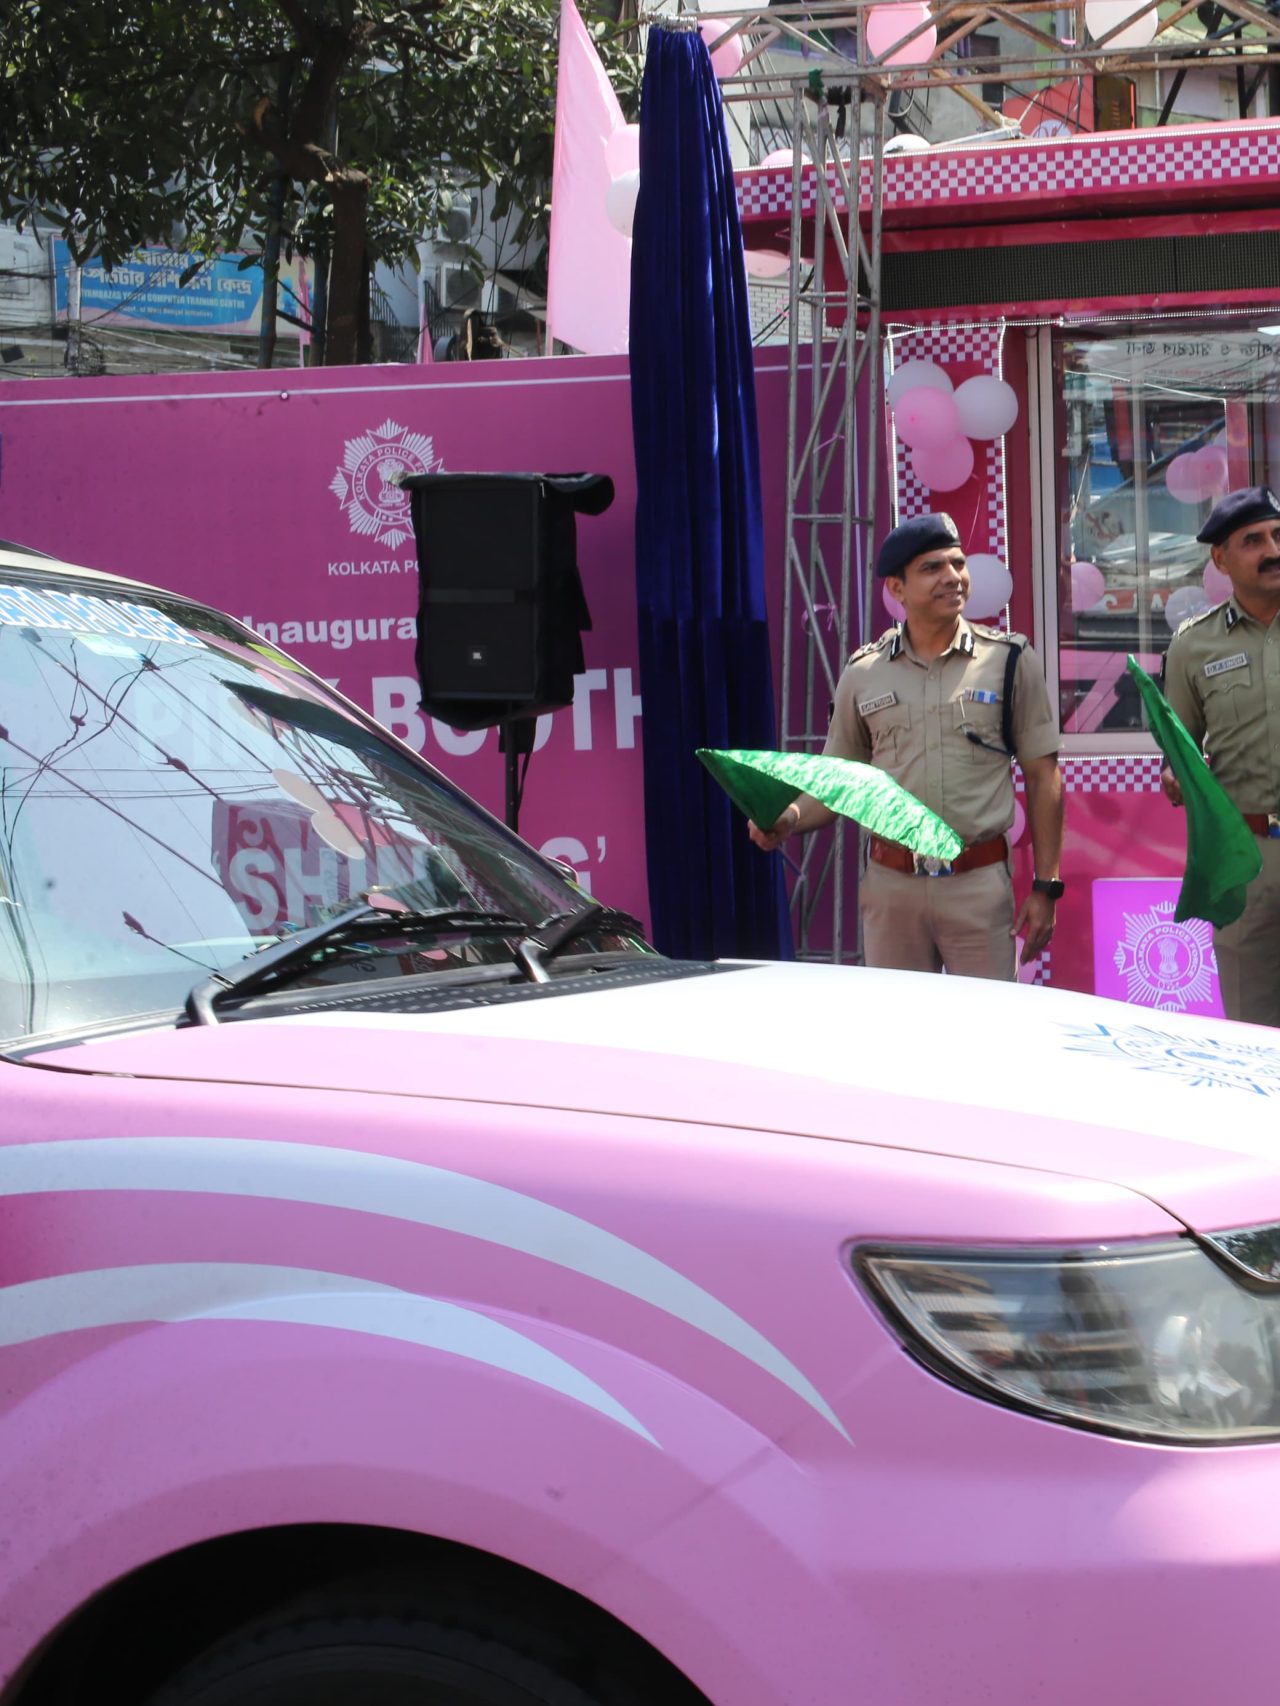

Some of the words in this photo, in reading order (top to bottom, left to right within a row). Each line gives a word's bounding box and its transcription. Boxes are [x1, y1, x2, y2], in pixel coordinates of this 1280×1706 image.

[327, 561, 401, 576] KOLKATA
[41, 589, 209, 649] POLICE
[371, 667, 643, 757] BTH
